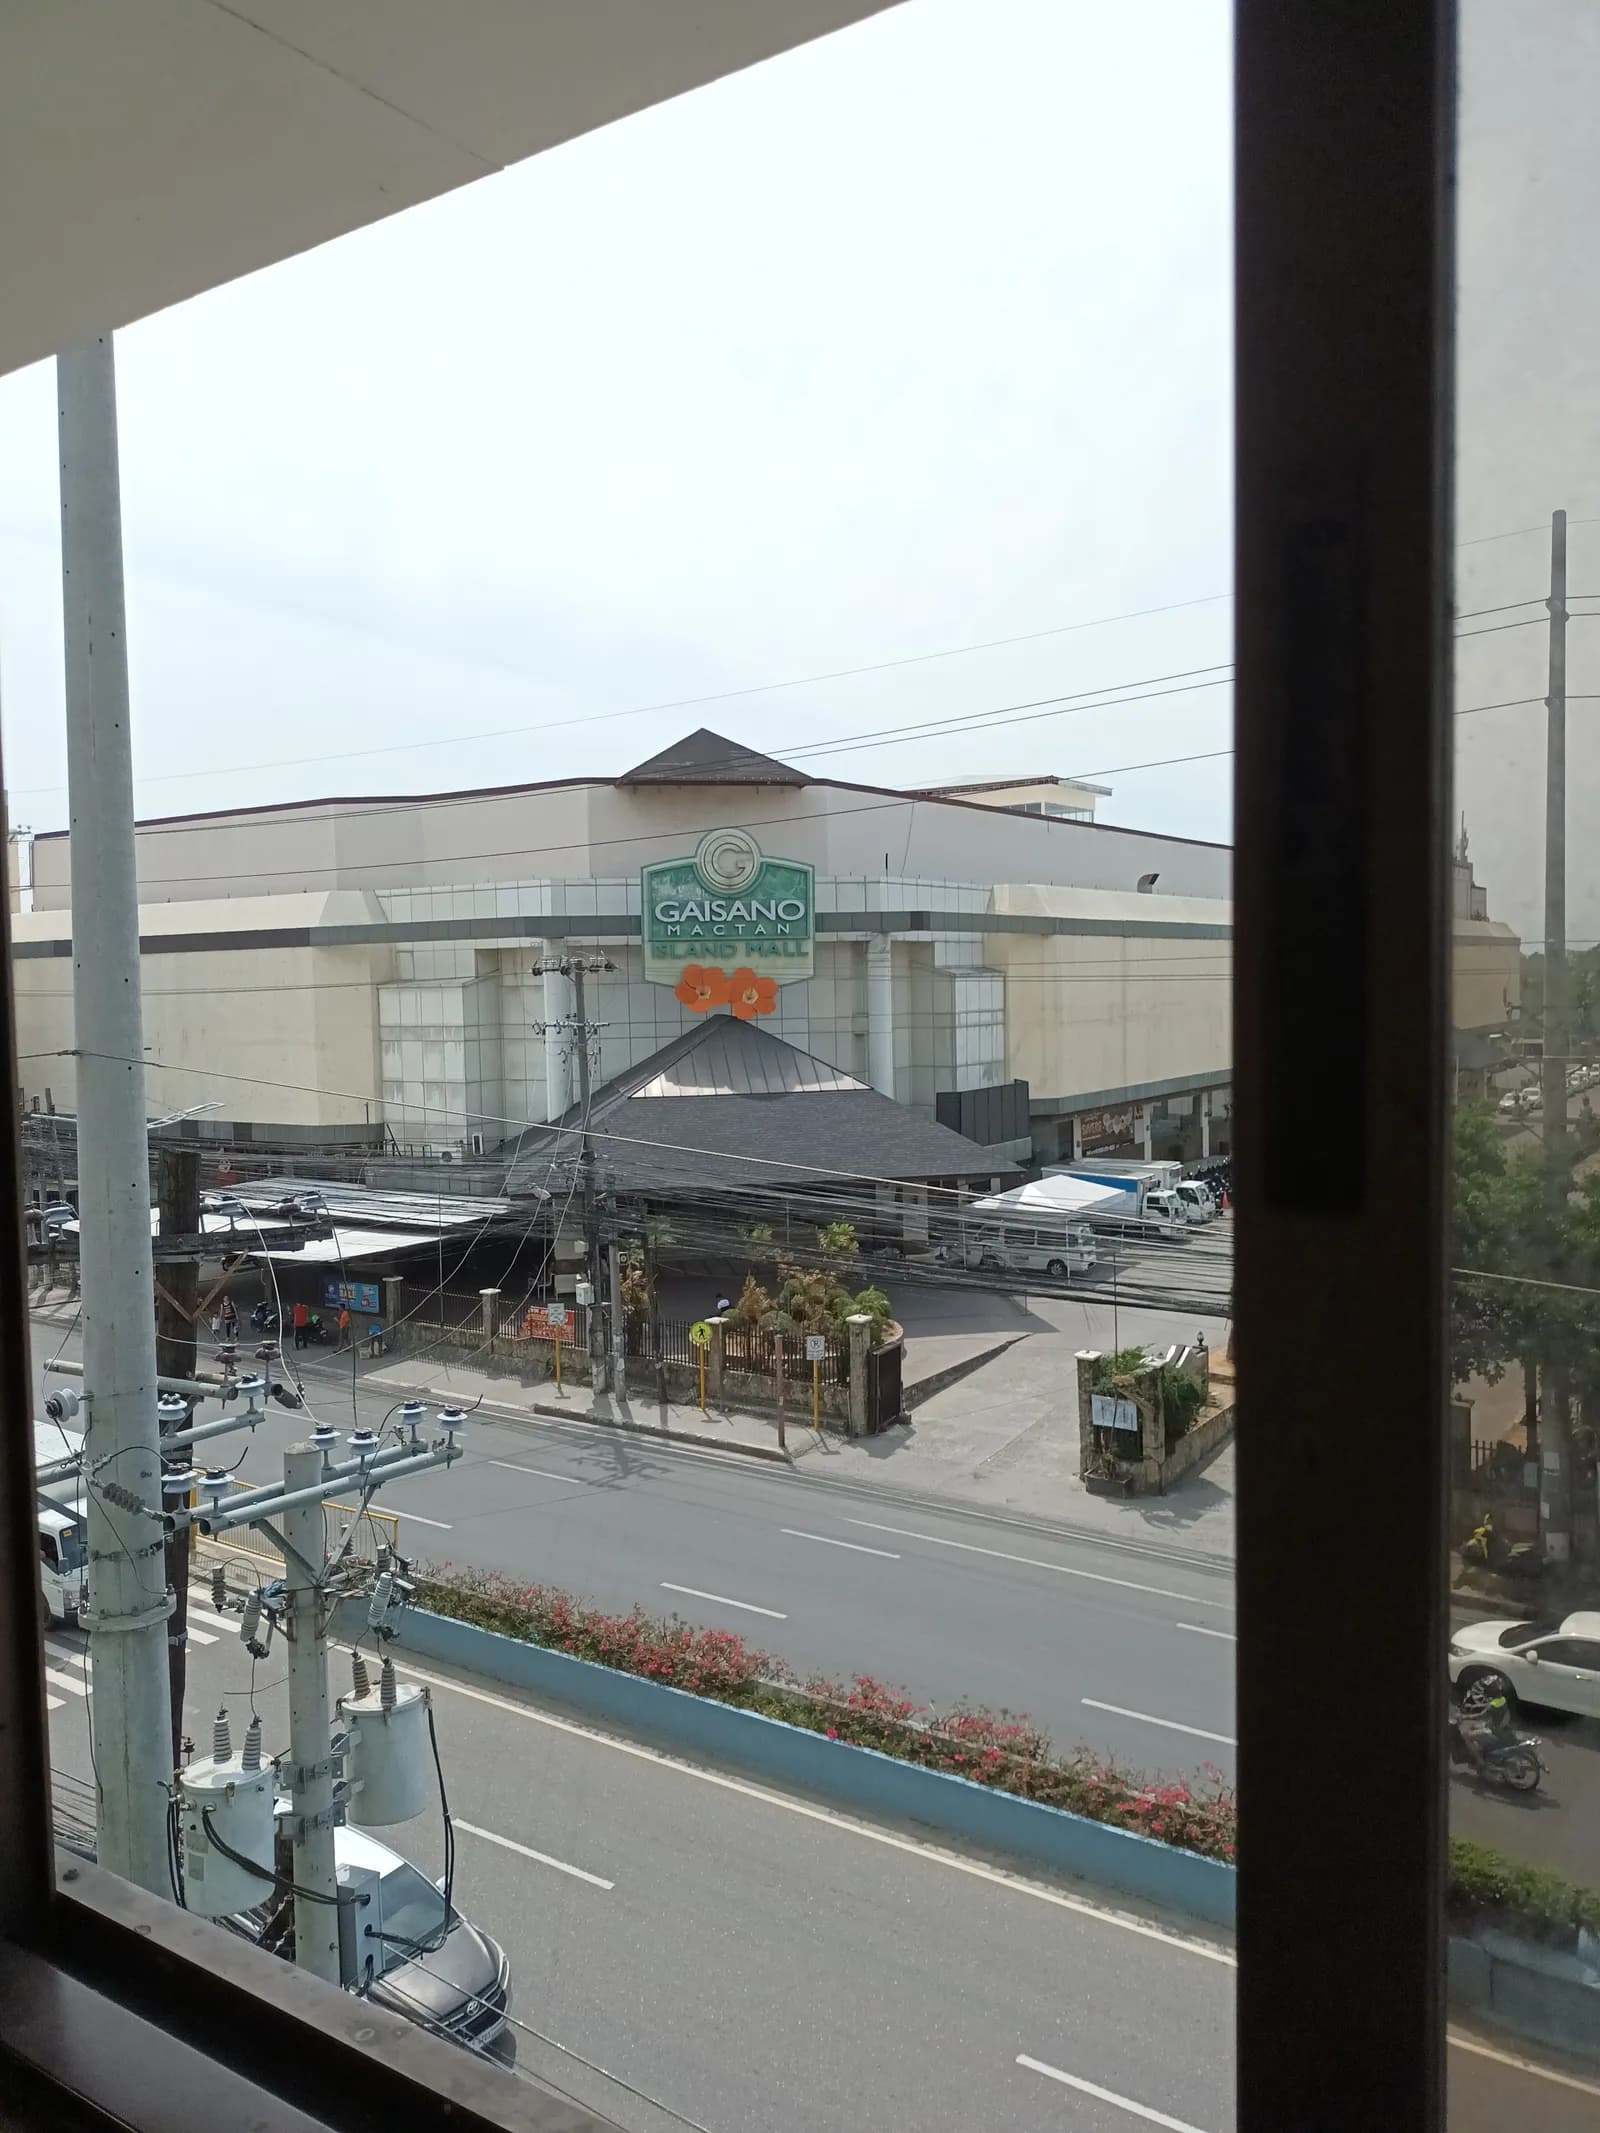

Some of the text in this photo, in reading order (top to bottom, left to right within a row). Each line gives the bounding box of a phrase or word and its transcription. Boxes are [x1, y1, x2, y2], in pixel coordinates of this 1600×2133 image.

[655, 900, 805, 922] GAISANO
[667, 923, 790, 936] MACTAN
[651, 940, 809, 960] ISLAND MALL
